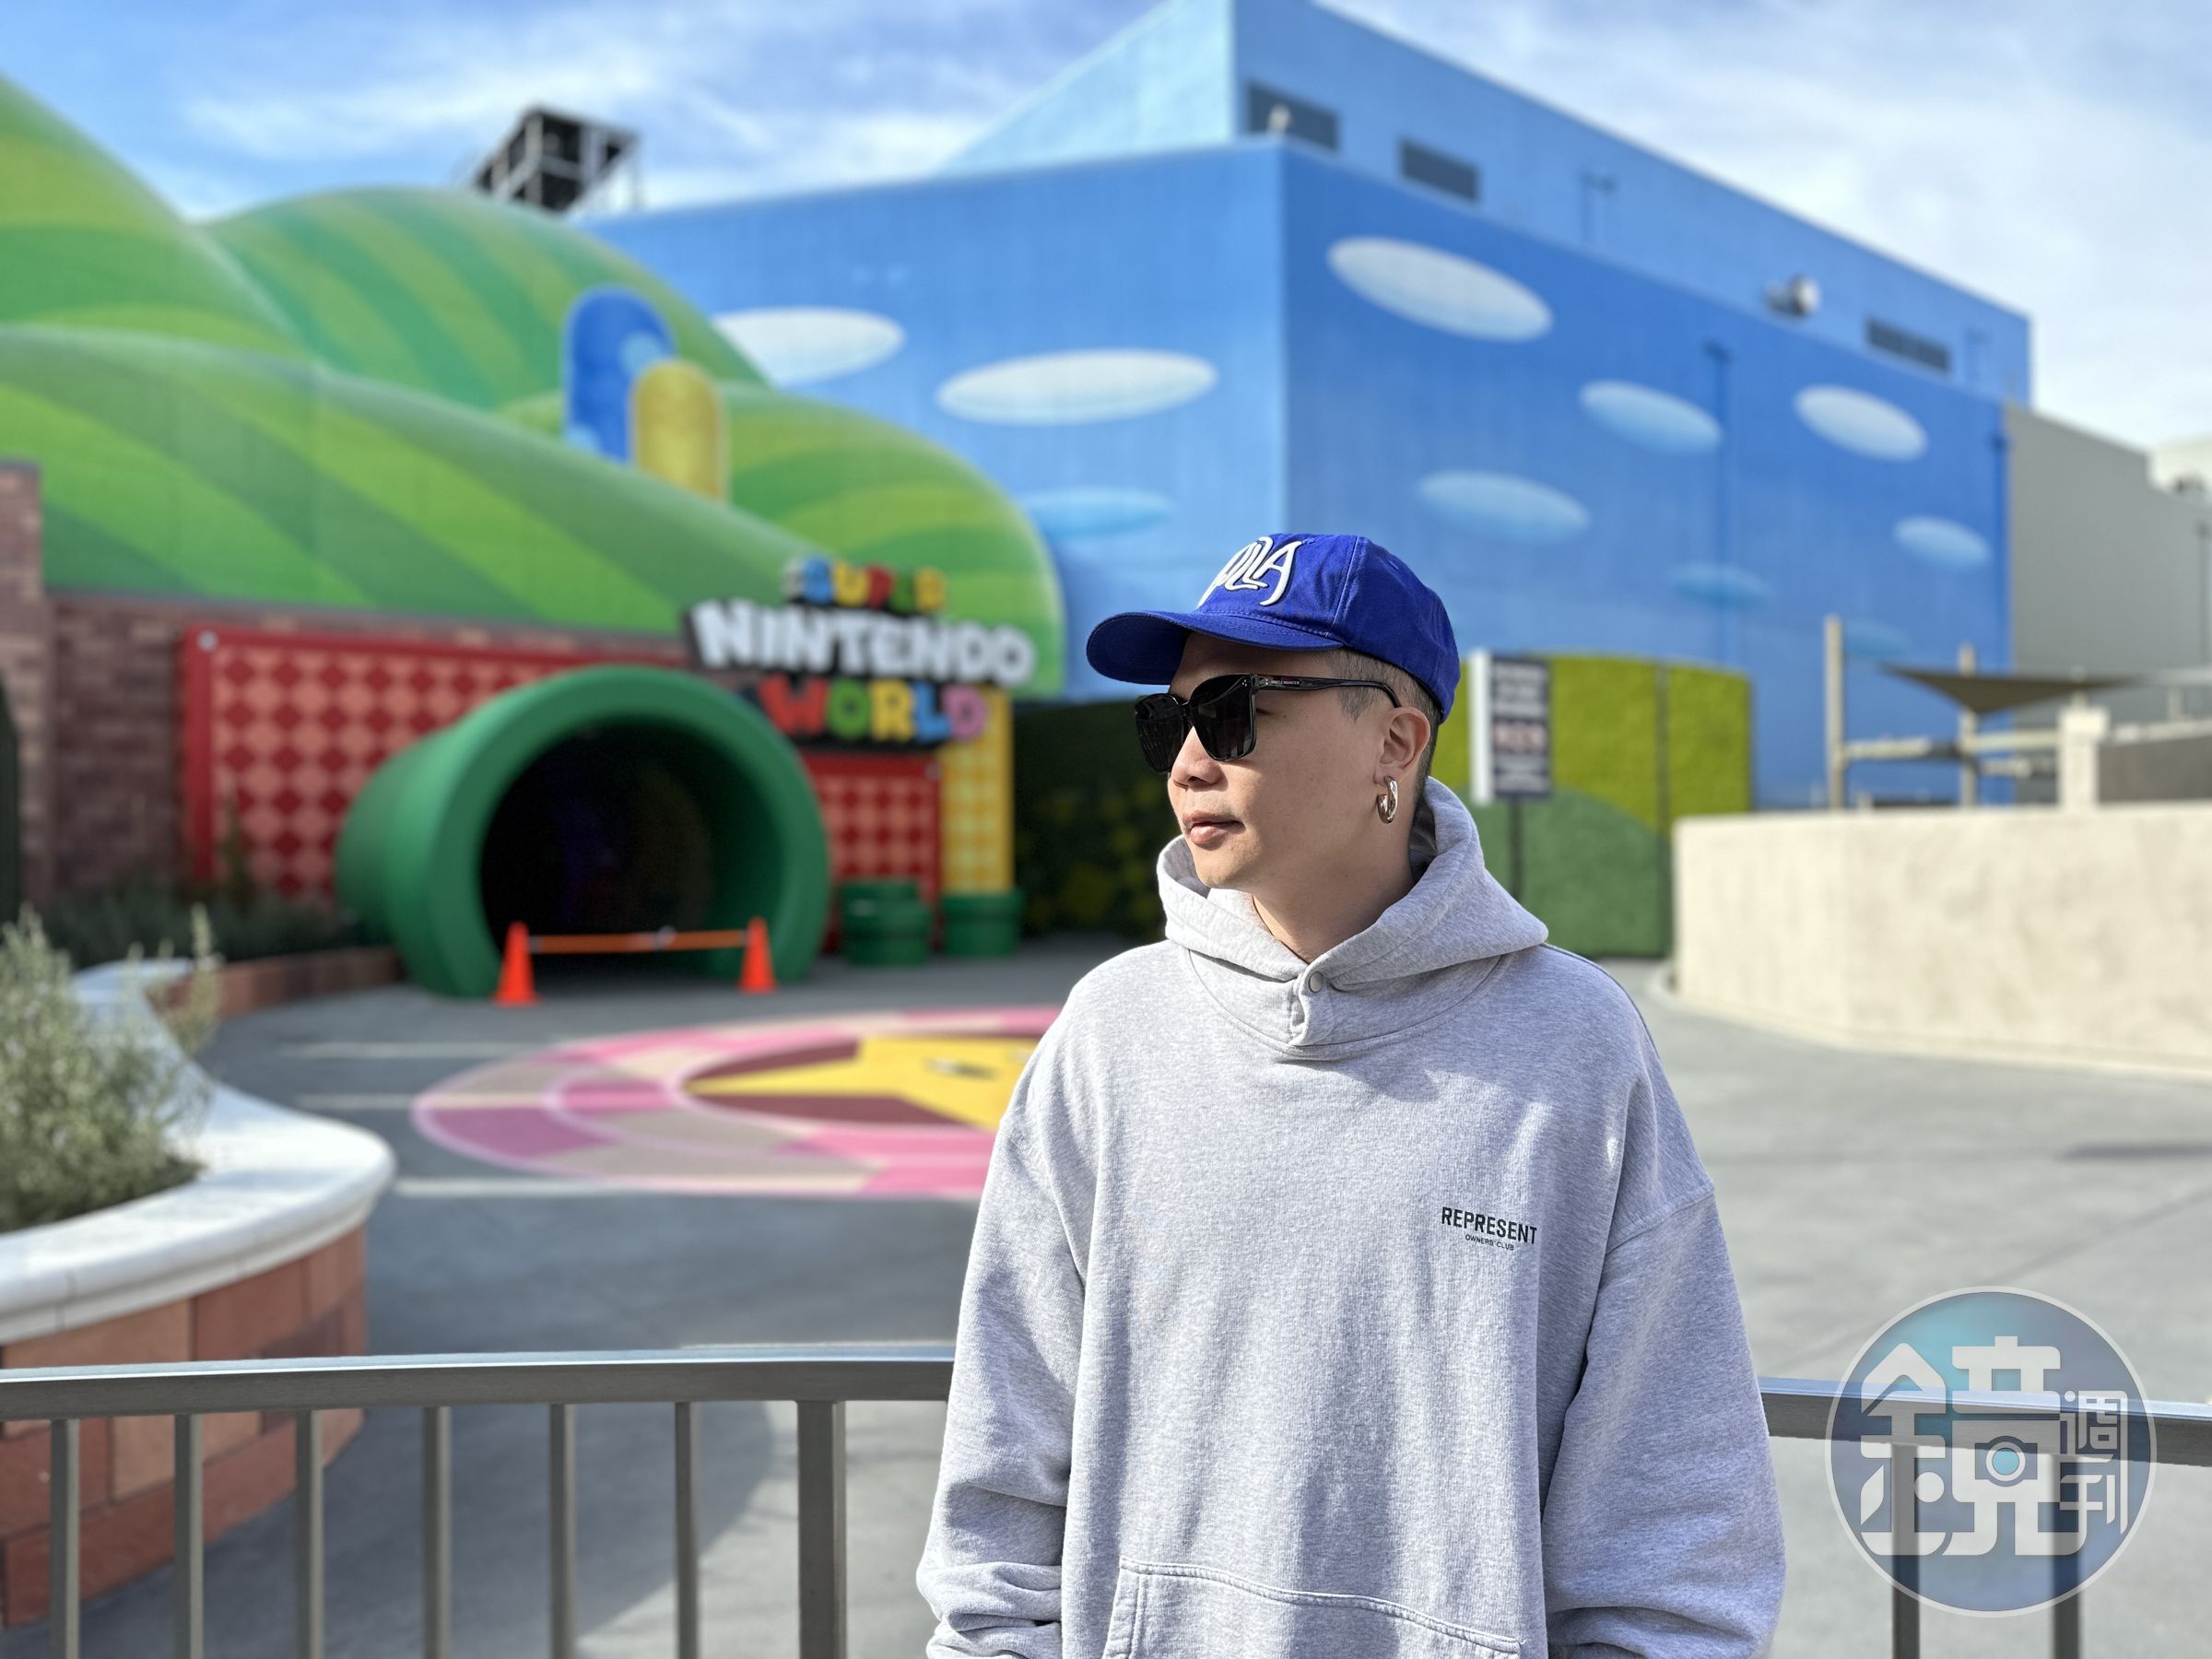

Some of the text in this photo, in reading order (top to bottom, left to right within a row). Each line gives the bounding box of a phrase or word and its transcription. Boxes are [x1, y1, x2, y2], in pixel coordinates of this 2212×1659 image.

[691, 597, 1035, 686] NINTENDO
[759, 674, 988, 743] WORLD
[1441, 1206, 1537, 1244] REPRESENT
[1496, 1241, 1514, 1251] CLUB
